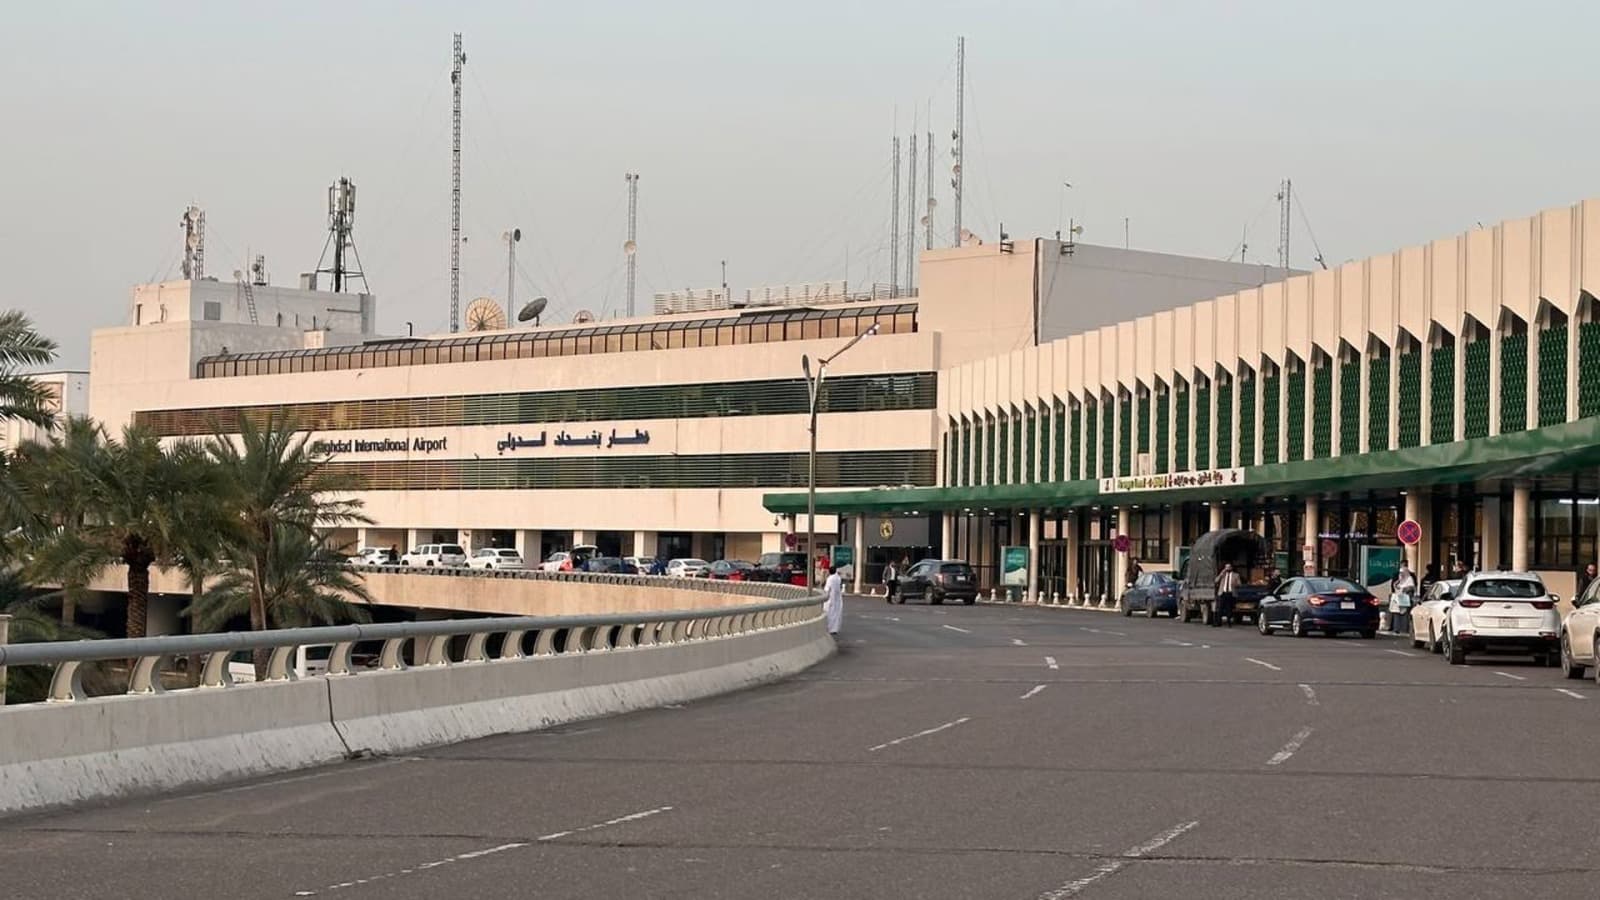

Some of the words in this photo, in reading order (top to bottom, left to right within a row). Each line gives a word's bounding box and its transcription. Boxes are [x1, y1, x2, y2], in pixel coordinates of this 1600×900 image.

[355, 437, 409, 452] International
[413, 436, 447, 454] Airport
[553, 429, 602, 450] بغداد
